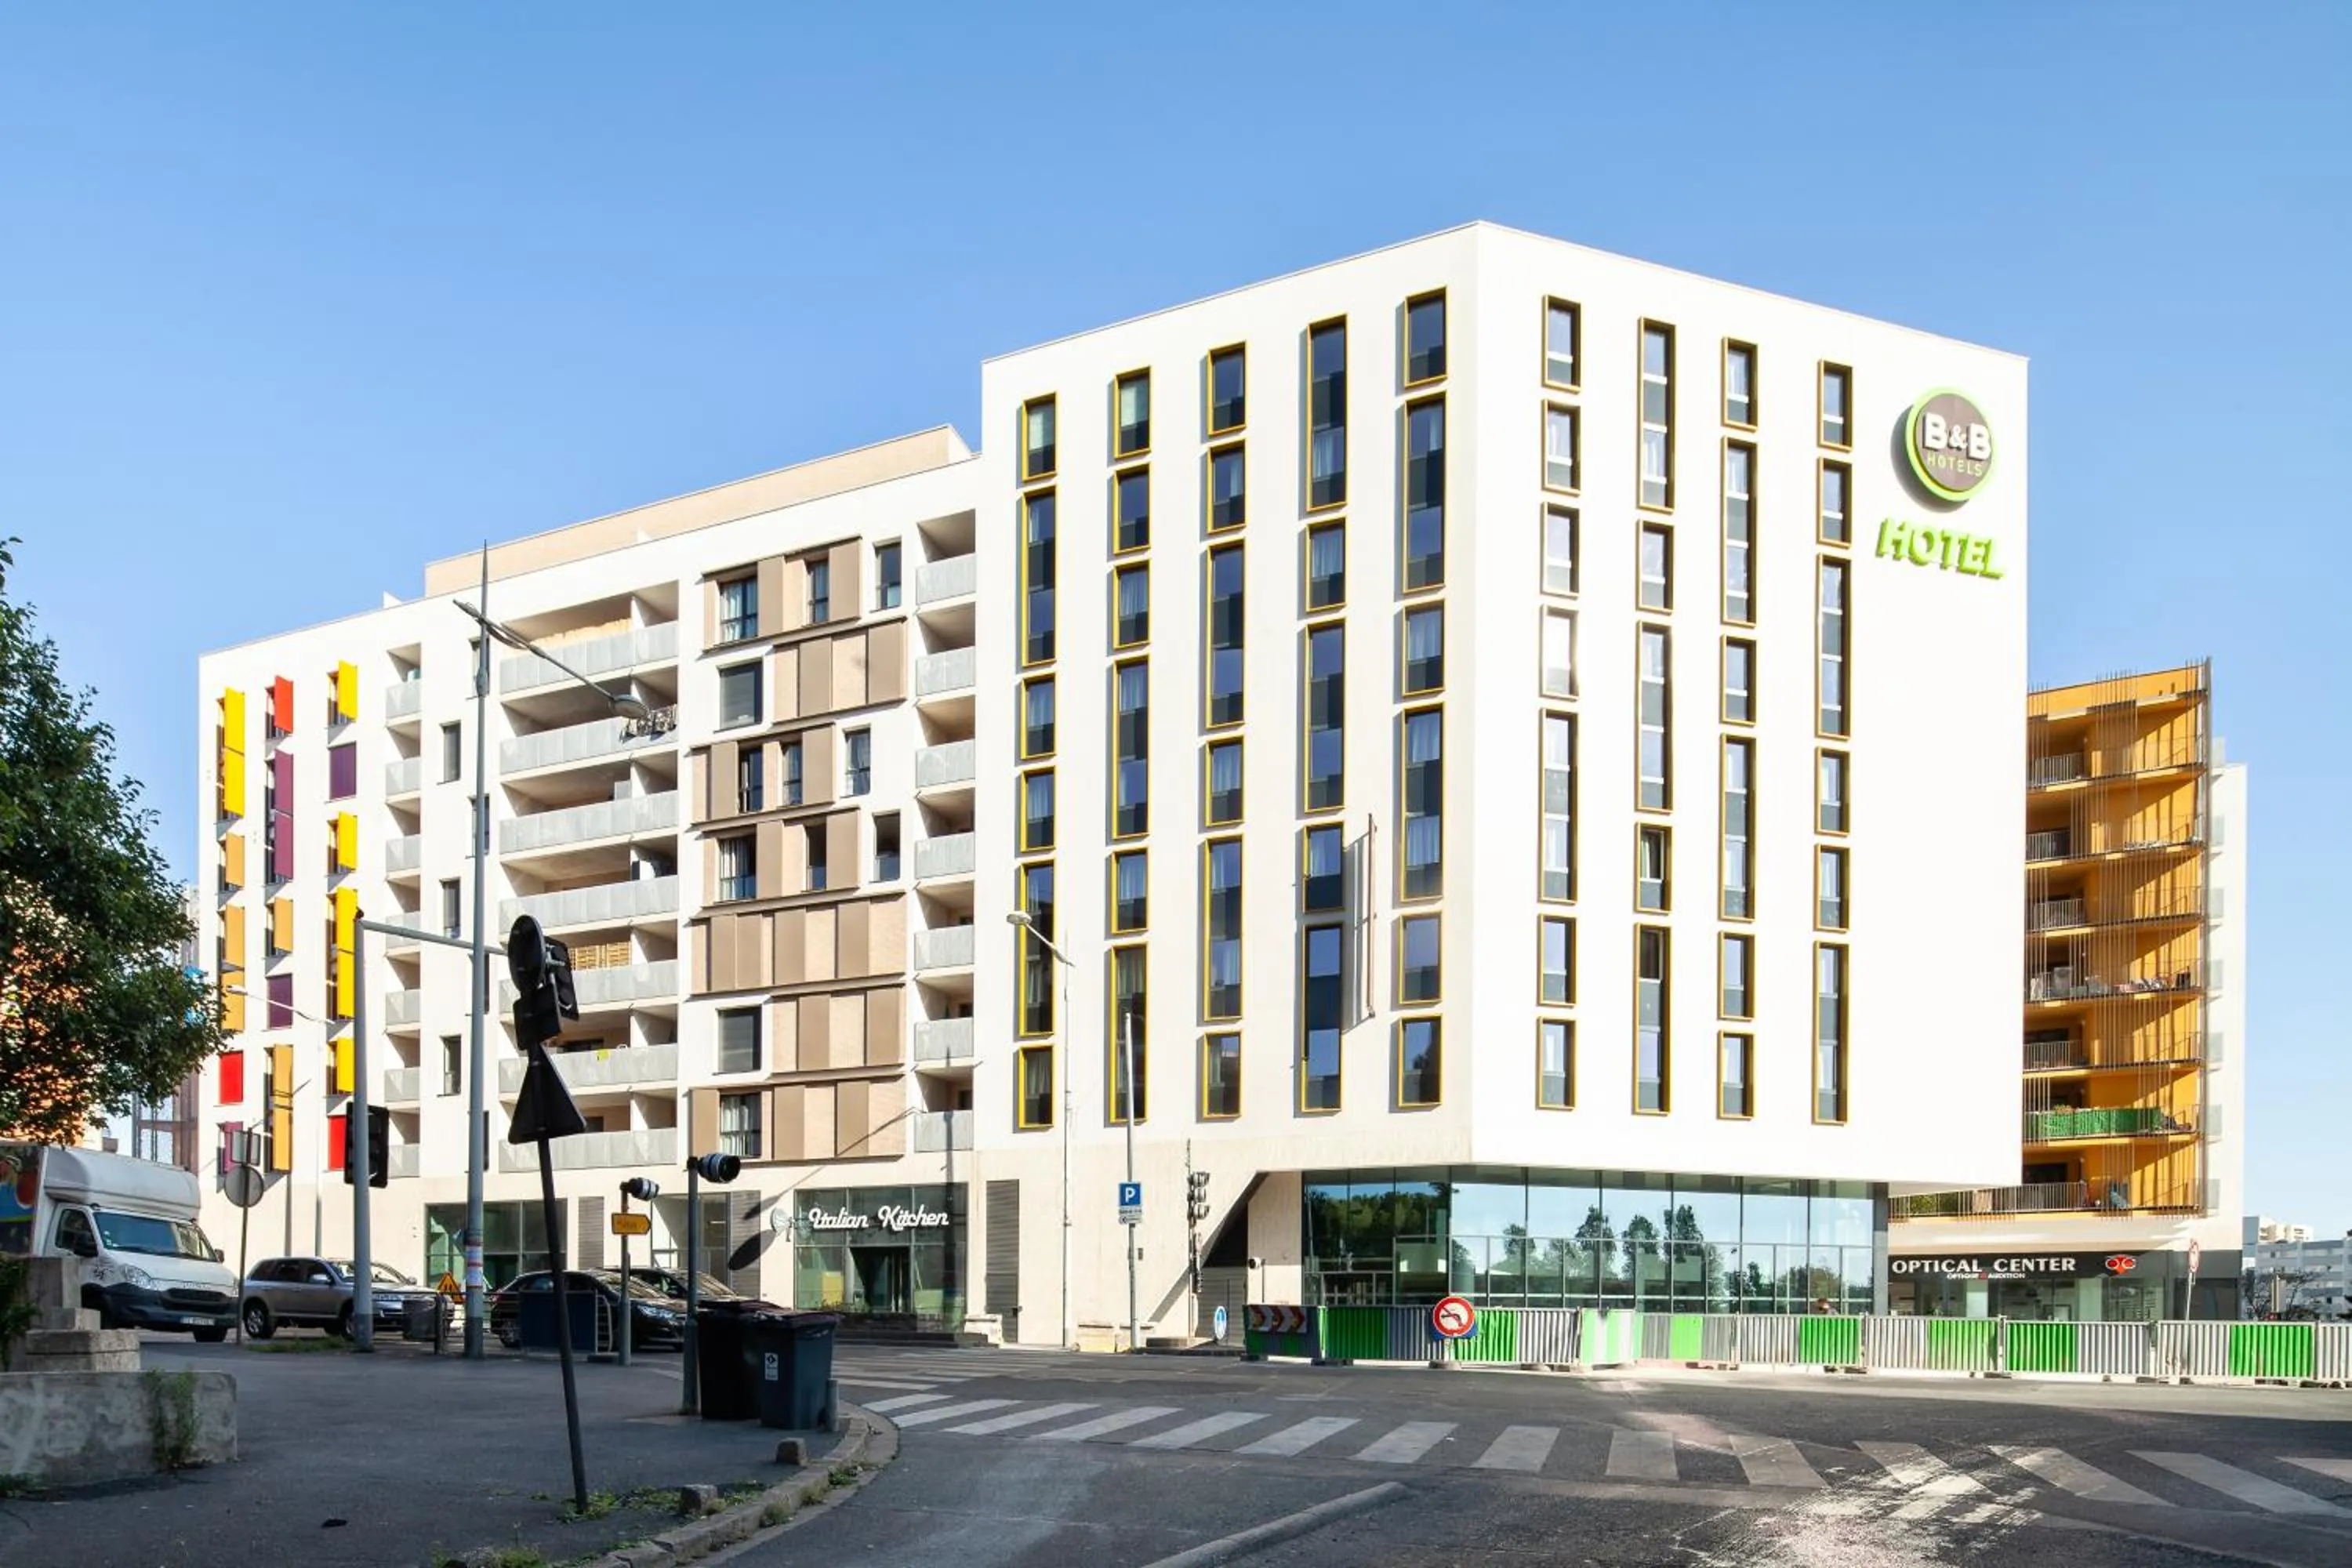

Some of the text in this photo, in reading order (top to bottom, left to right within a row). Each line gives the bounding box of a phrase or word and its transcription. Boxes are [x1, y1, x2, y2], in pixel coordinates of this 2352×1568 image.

[1922, 412, 1992, 462] B&B
[1926, 451, 1984, 478] HOTELS
[1875, 517, 2004, 580] HOTEL
[1125, 1187, 1136, 1203] P
[808, 1203, 949, 1232] Italian Kitchen
[1891, 1258, 2077, 1274] OPTICAL CENTER
